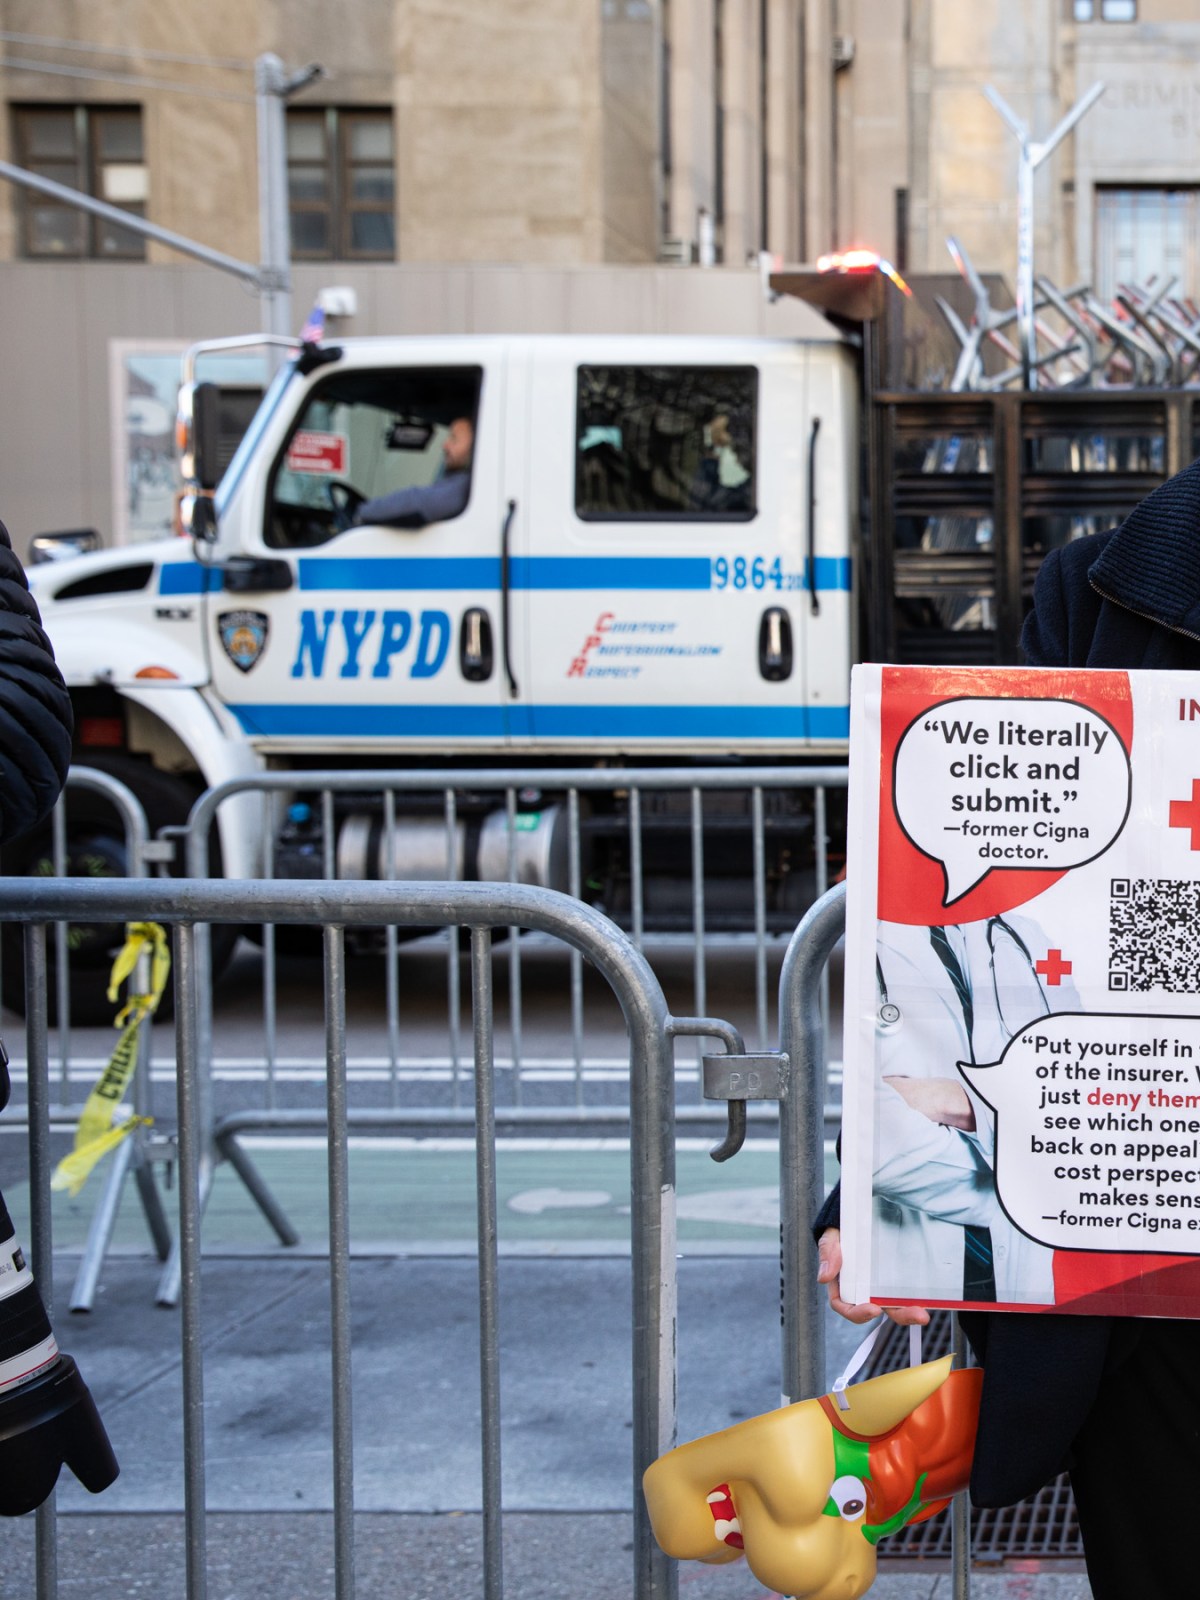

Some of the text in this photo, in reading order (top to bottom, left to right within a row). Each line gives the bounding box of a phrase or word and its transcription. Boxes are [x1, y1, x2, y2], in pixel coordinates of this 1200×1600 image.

[712, 556, 782, 591] 9864
[291, 609, 452, 680] NYPD
[999, 721, 1108, 754] literally
[950, 754, 1080, 780] click and
[1033, 821, 1089, 843] Cigna
[978, 842, 1048, 859] doctor.
[1077, 1038, 1168, 1060] yourself
[1174, 1039, 1192, 1058] in
[729, 1072, 762, 1091] PD
[1036, 1061, 1059, 1079] of
[1064, 1061, 1101, 1080] the
[1108, 1062, 1189, 1083] insurer.
[1039, 1085, 1081, 1109] just
[1087, 1087, 1142, 1112] deny
[1044, 1116, 1081, 1130] see
[1087, 1112, 1152, 1131] which
[1031, 1135, 1084, 1155] back
[1090, 1143, 1116, 1156] on
[1054, 1164, 1101, 1180] cost
[1079, 1187, 1149, 1206] makes
[1127, 1212, 1181, 1233] Cigna
